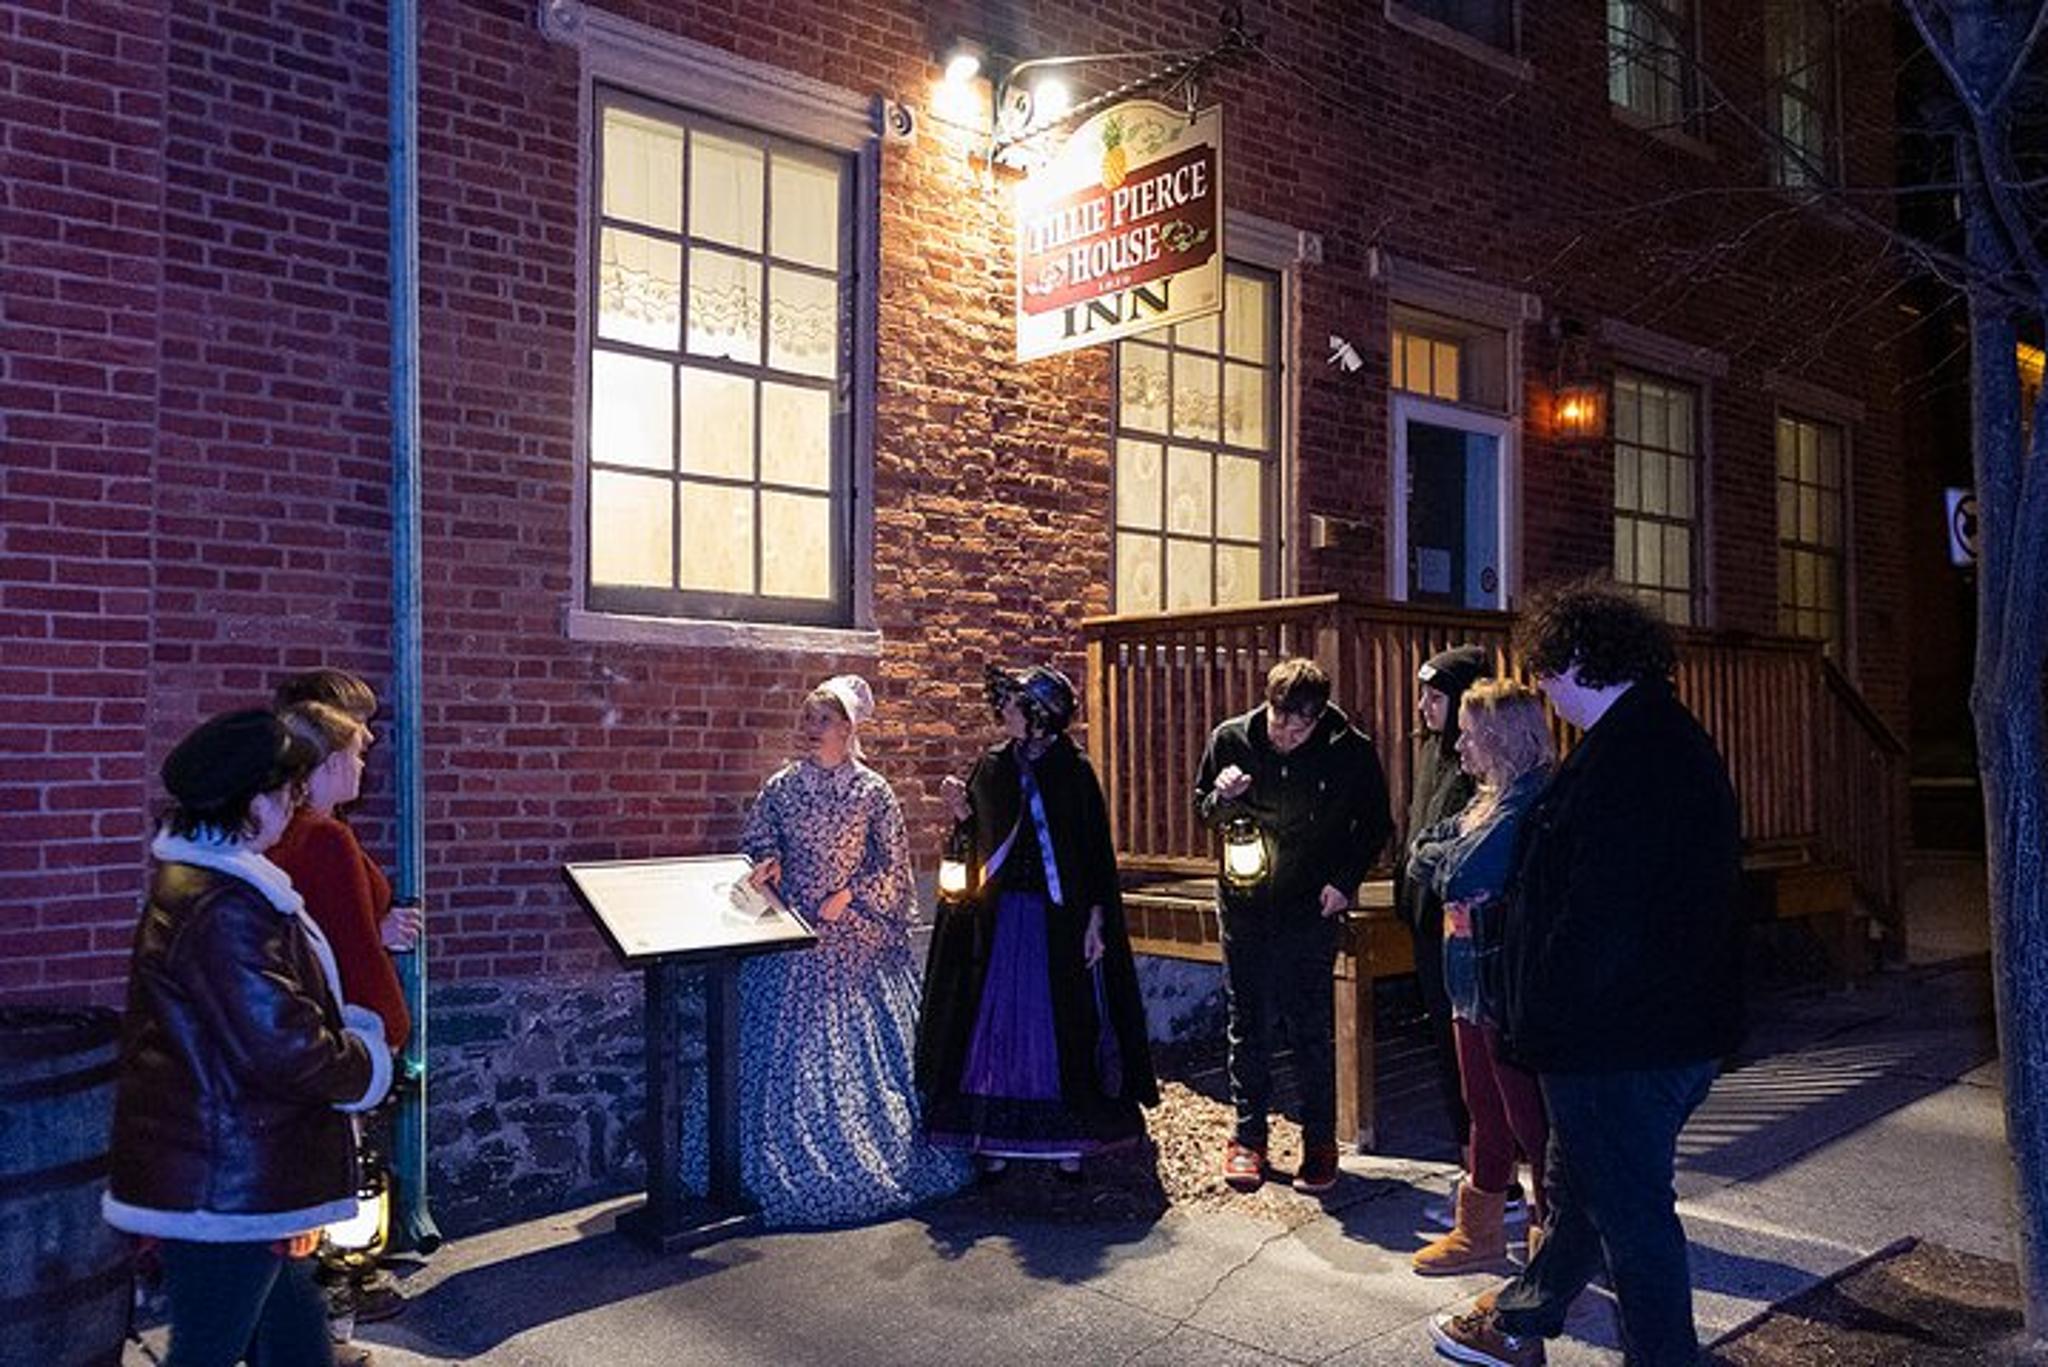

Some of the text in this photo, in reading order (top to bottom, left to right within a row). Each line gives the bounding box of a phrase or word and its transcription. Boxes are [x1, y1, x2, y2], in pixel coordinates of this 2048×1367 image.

[1112, 160, 1208, 228] PIERCE
[1071, 223, 1161, 286] HOUSE
[1062, 276, 1174, 339] INN
